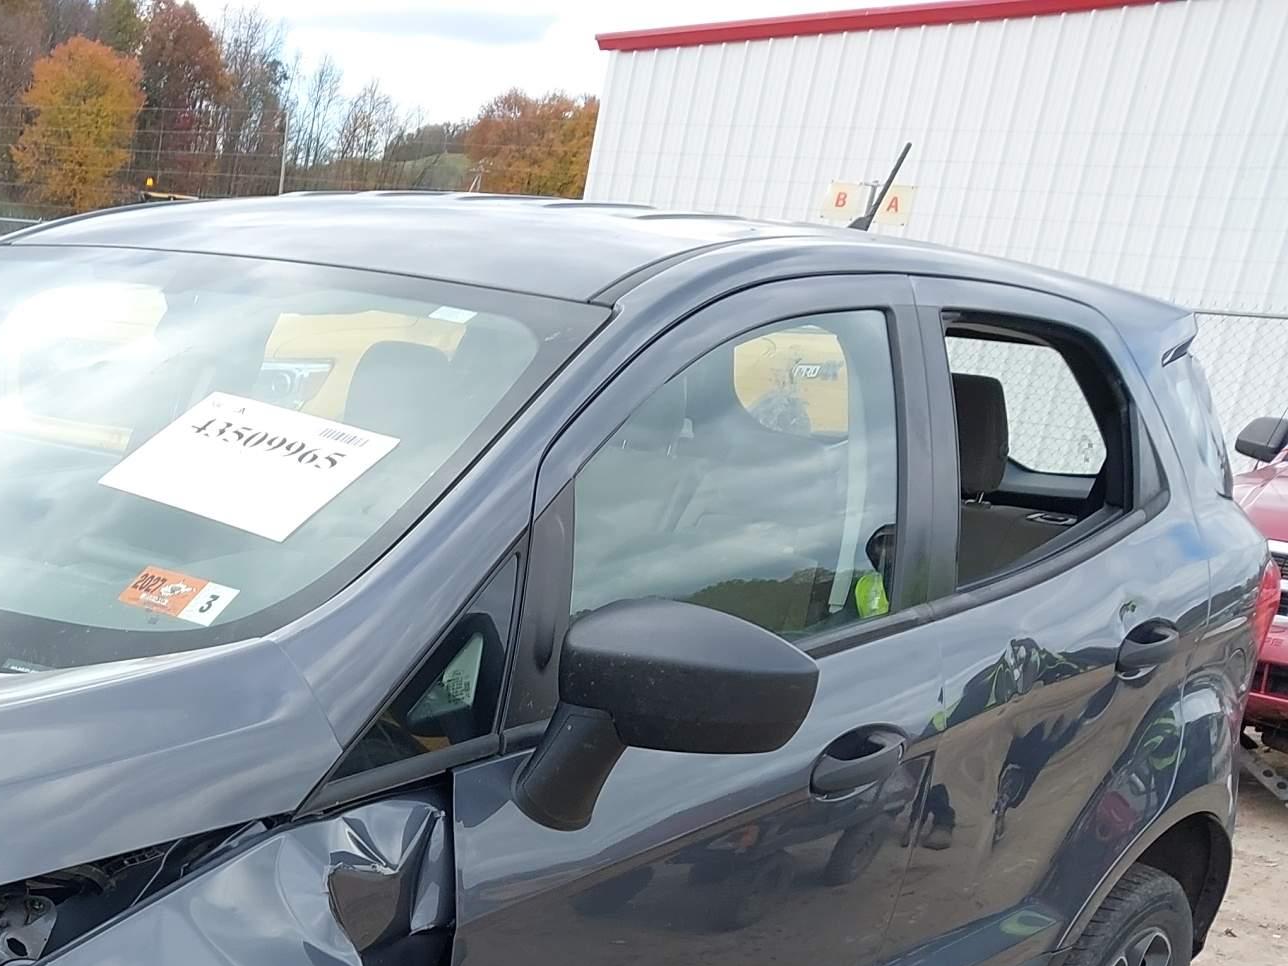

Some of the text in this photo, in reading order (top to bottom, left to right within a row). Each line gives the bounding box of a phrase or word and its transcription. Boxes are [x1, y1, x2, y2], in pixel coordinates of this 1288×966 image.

[834, 191, 848, 208] B
[885, 195, 899, 213] A
[191, 418, 347, 470] 43509965
[198, 594, 220, 614] 3
